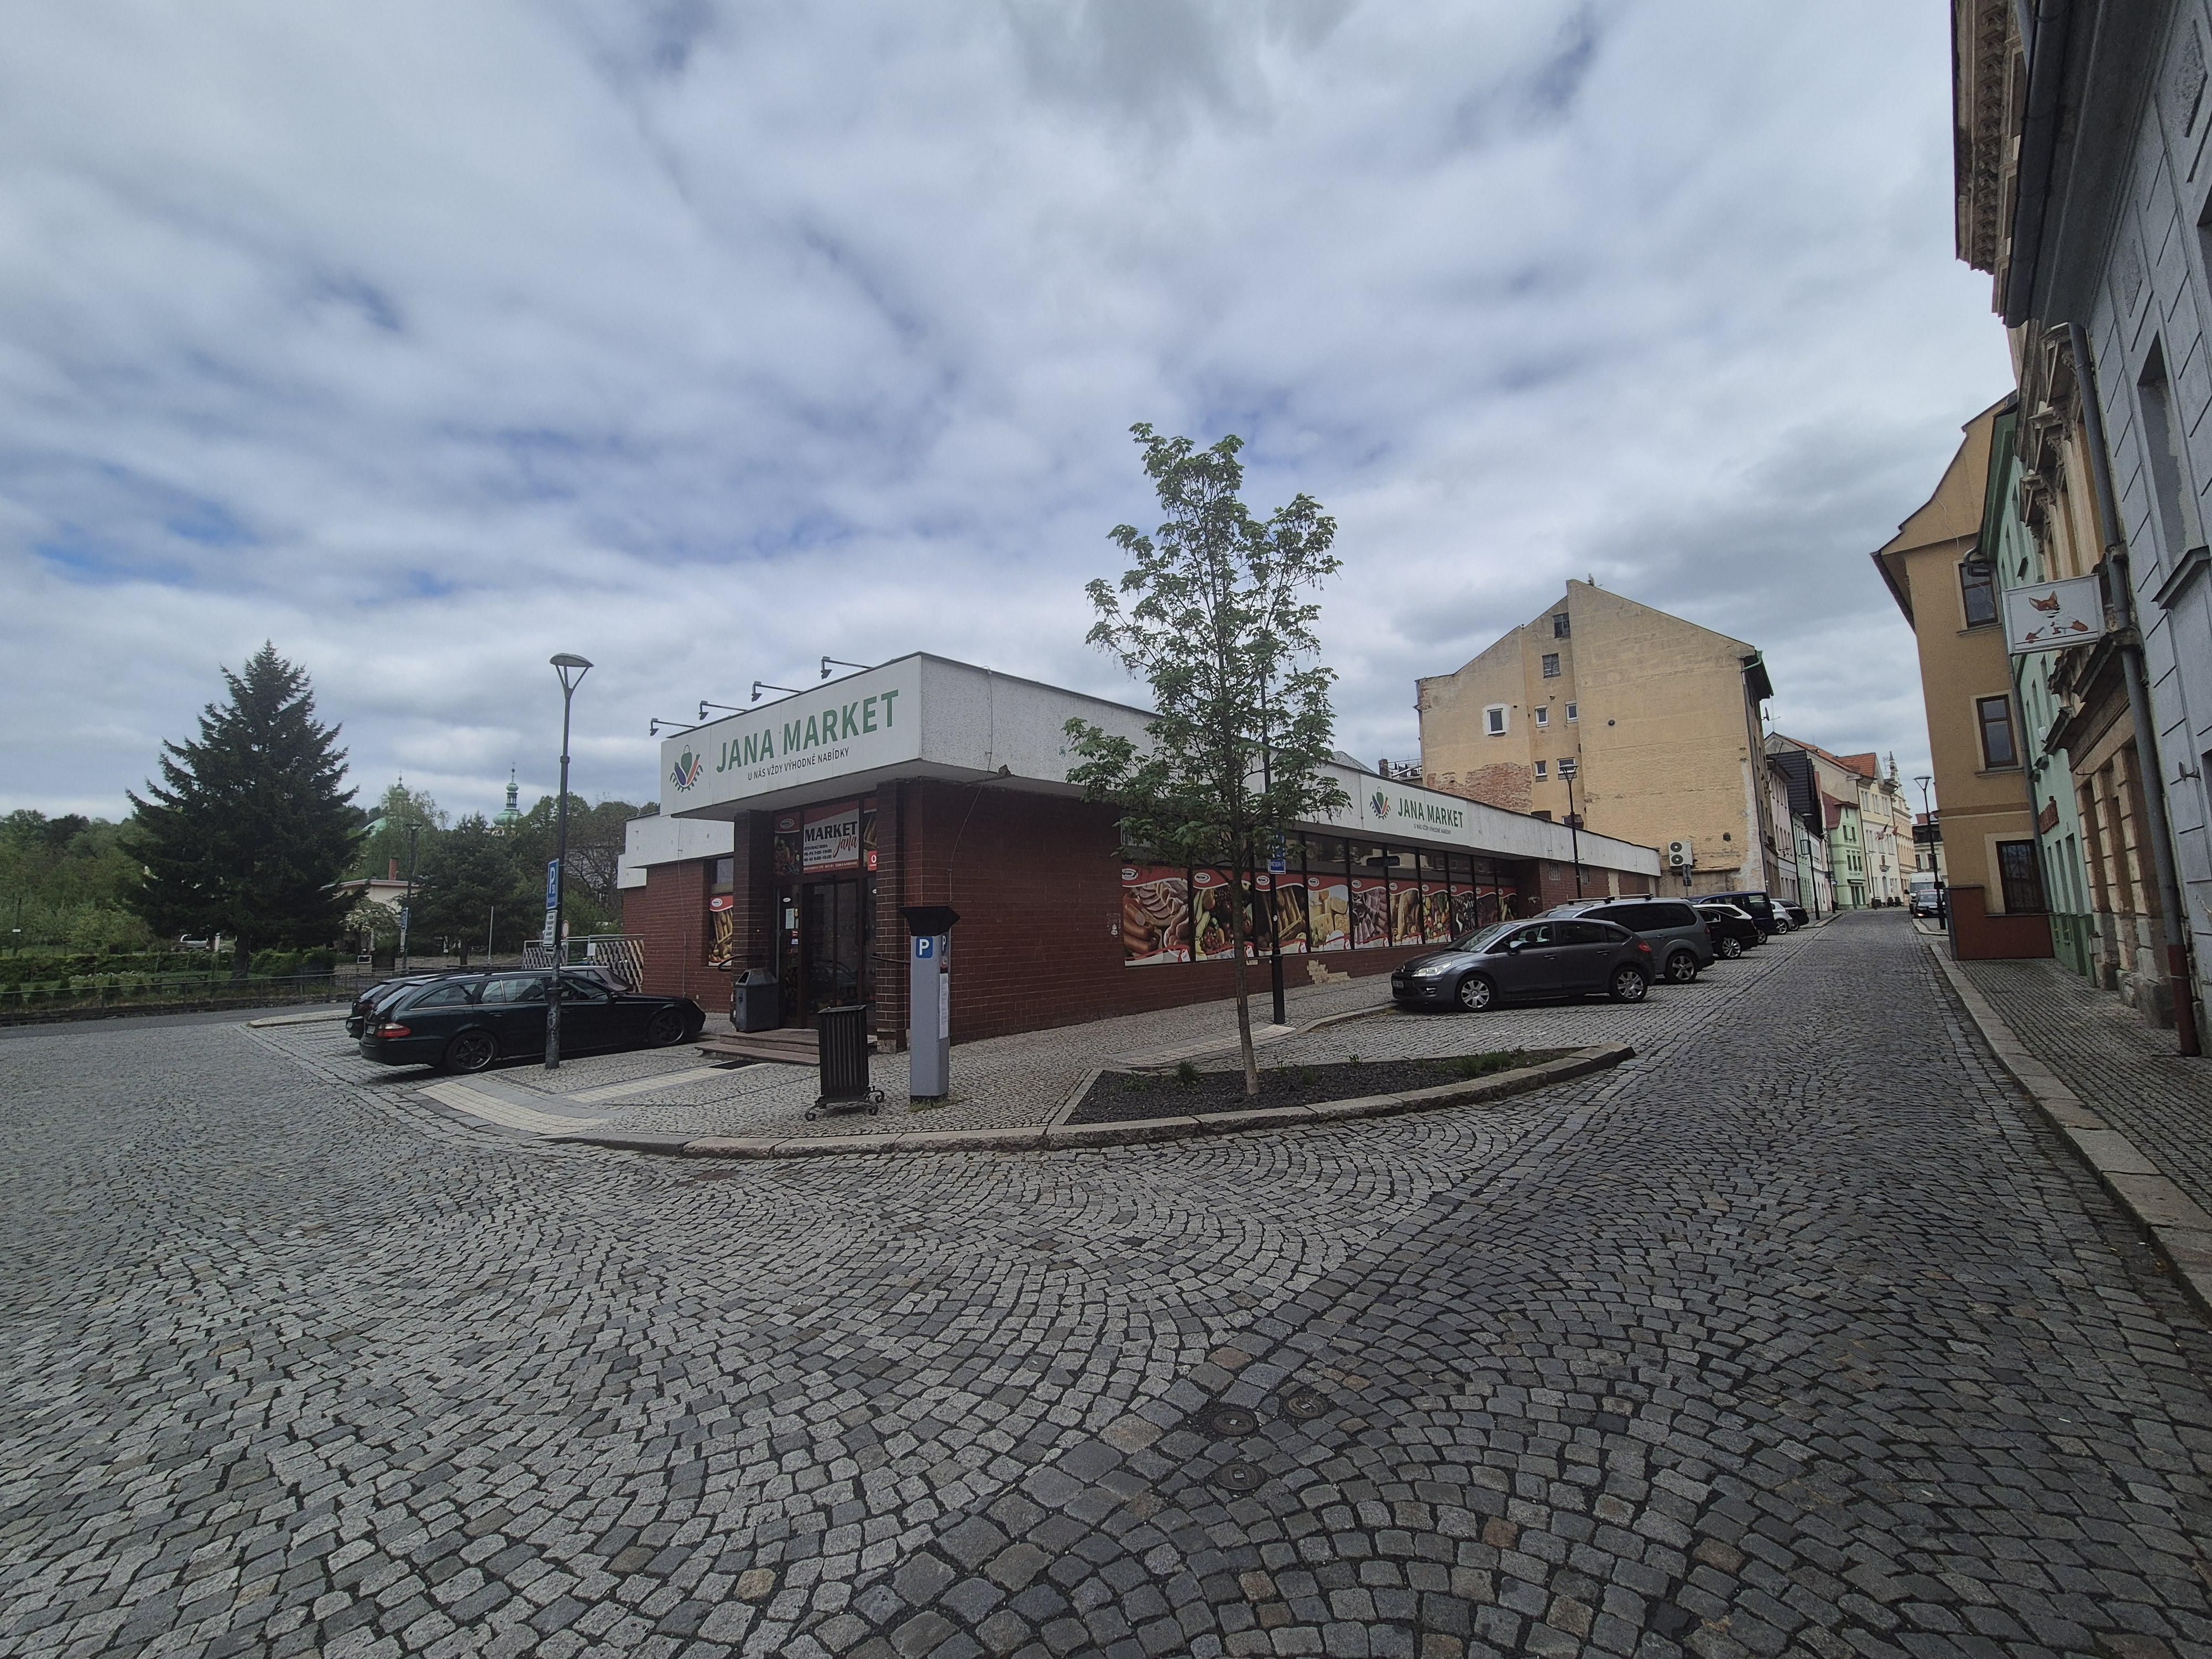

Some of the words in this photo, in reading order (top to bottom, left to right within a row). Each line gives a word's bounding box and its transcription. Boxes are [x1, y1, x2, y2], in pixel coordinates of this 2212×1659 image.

[717, 729, 774, 773] JANA
[784, 689, 899, 755] MARKET
[754, 767, 765, 779] NÁS
[768, 764, 782, 776] VŽDY
[784, 753, 816, 771] VÝHODNÉ
[818, 747, 849, 764] NABÍDKY
[1398, 797, 1425, 821] JANA
[1427, 804, 1463, 828] MARKET
[805, 821, 858, 842] MARKET
[919, 939, 930, 956] P
